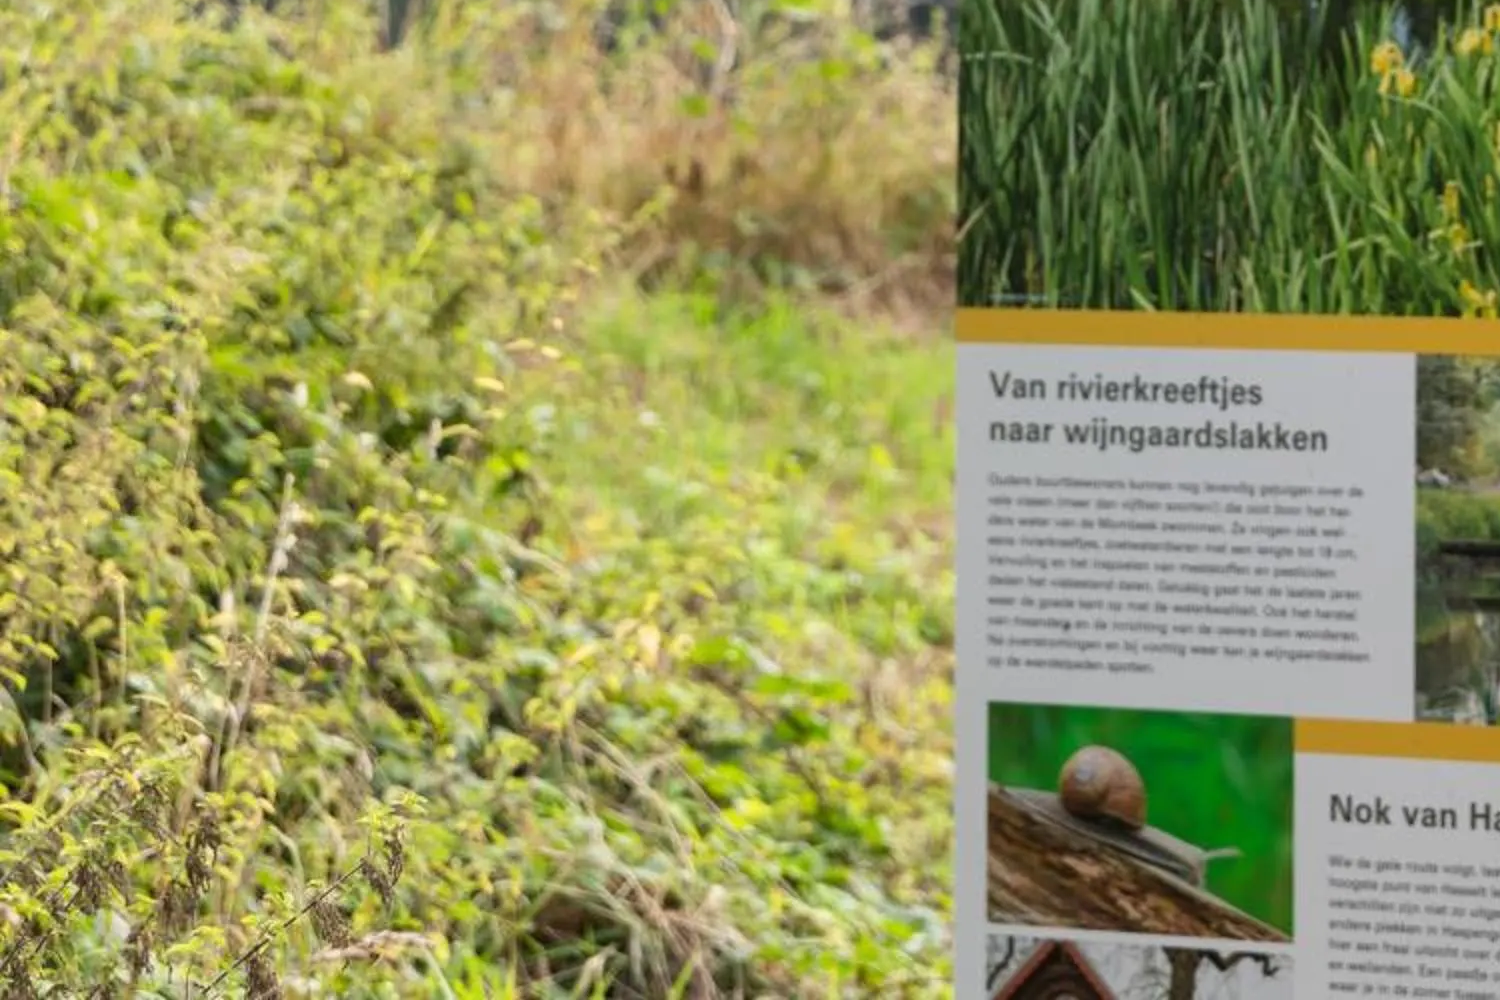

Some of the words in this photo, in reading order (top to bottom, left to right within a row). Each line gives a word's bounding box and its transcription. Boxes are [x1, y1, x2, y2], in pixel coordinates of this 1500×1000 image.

[989, 370, 1046, 400] Van
[1057, 373, 1263, 411] rivierkreeftjes
[989, 419, 1053, 443] naar
[1063, 417, 1328, 453] wijngaardslakken
[1329, 794, 1391, 826] Nok
[1402, 806, 1458, 830] van
